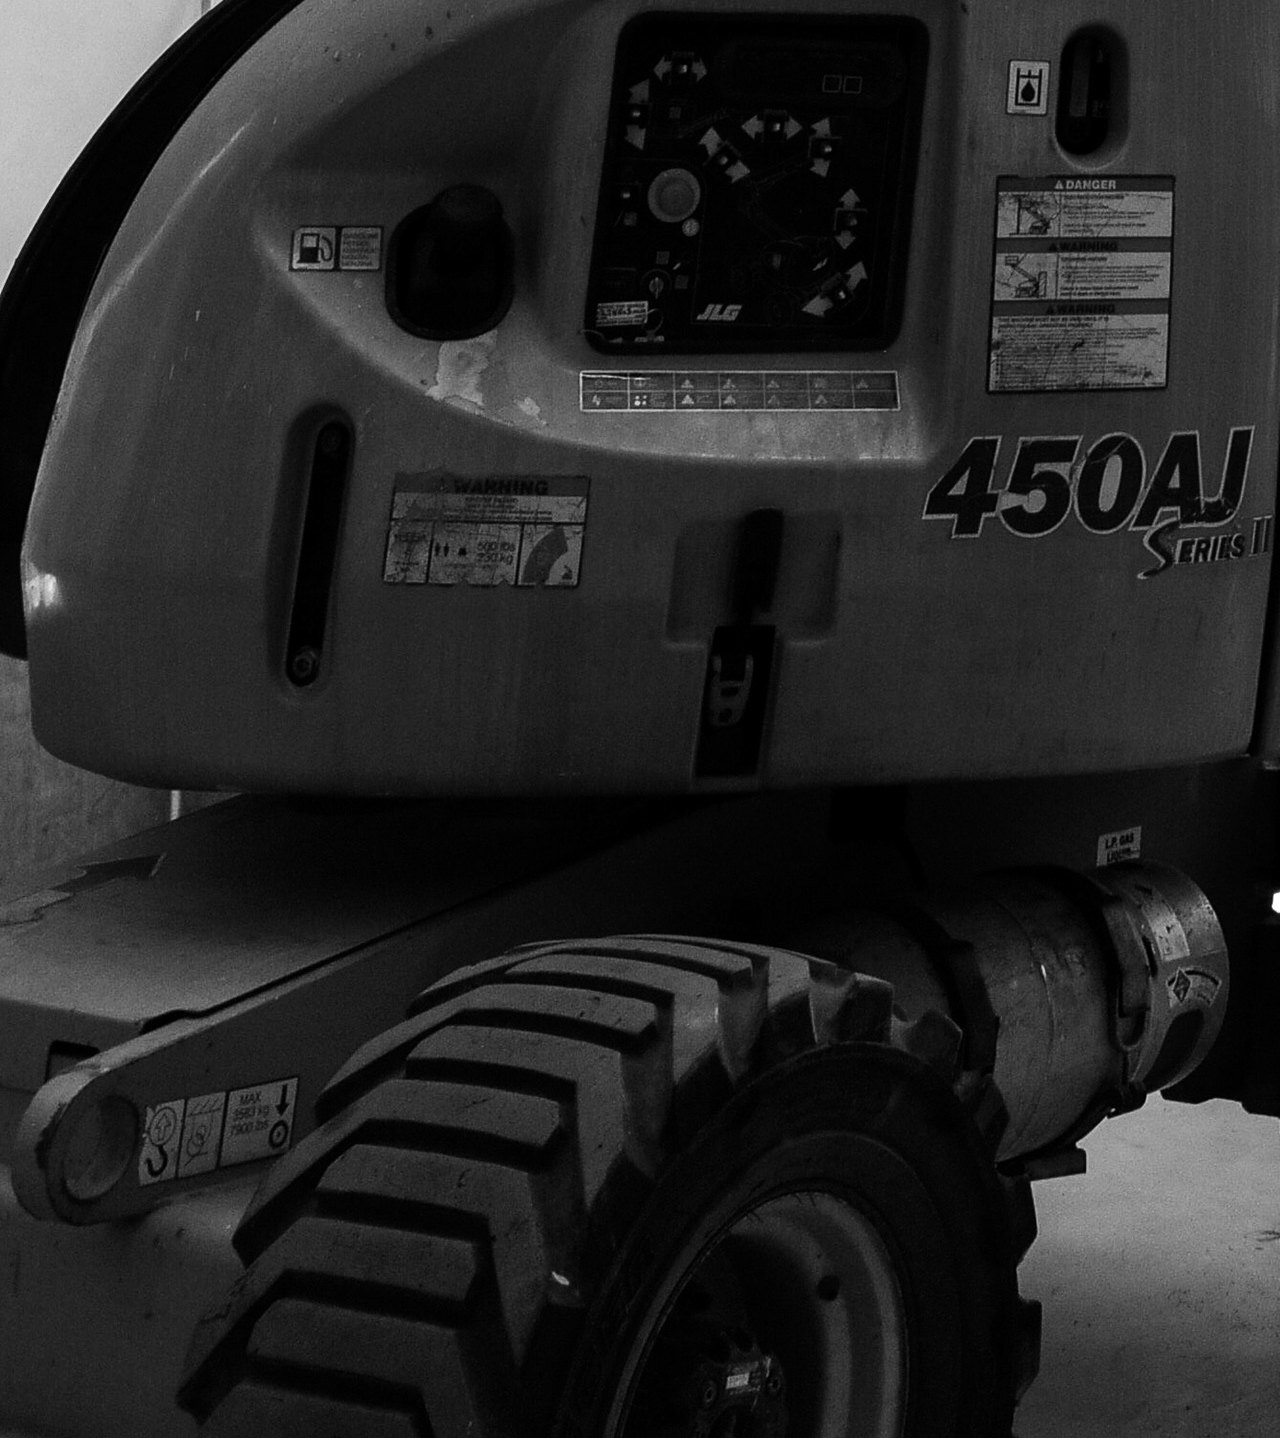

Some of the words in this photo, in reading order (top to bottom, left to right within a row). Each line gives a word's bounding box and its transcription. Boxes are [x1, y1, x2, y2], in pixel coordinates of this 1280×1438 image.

[1065, 179, 1117, 190] DANGER
[696, 303, 744, 321] JLG
[921, 425, 1256, 539] 450AJ
[240, 1091, 262, 1105] MAX
